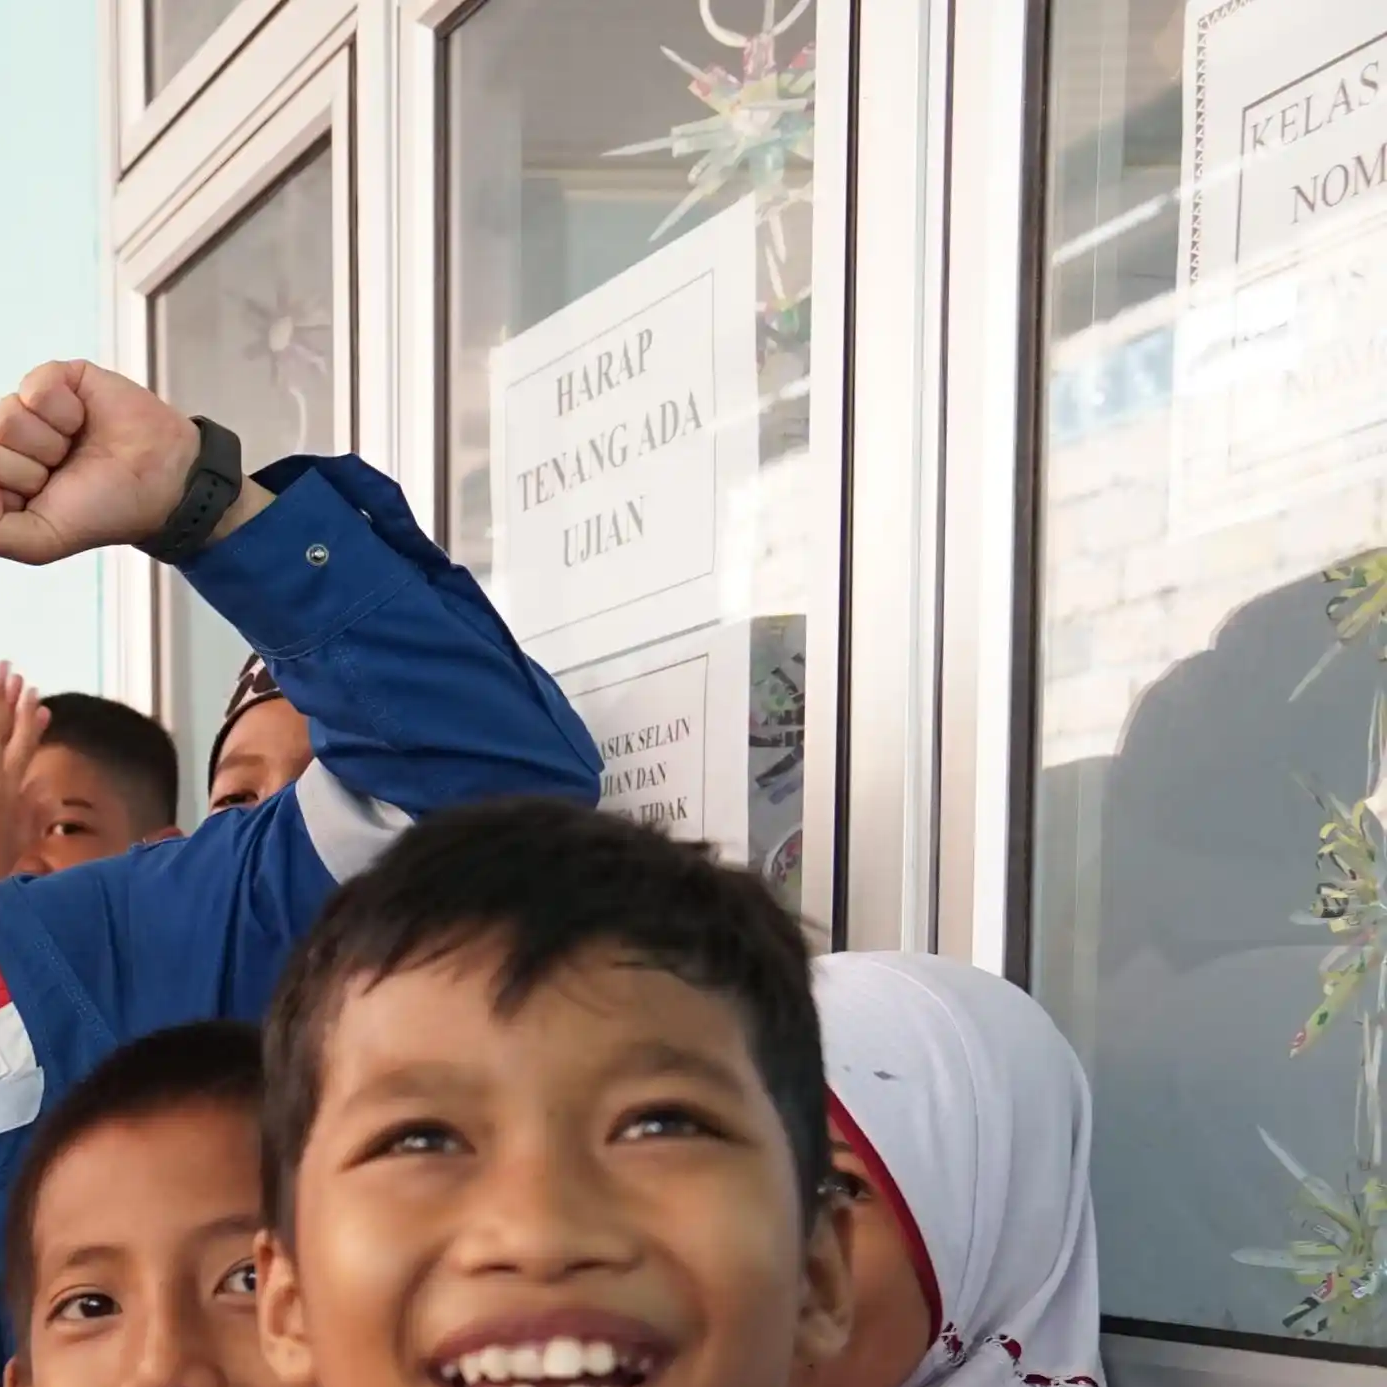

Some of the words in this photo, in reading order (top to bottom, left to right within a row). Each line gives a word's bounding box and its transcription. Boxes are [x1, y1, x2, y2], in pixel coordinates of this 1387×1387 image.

[1251, 61, 1380, 151] KELAS
[555, 328, 653, 417] HARAP
[517, 422, 628, 512] TENANG
[637, 387, 703, 457] ADA
[563, 495, 646, 568] UJIAN
[638, 716, 691, 751] SELAIN
[601, 769, 632, 797] JIAN
[635, 761, 667, 790] DAN
[639, 796, 688, 825] TIDAK
